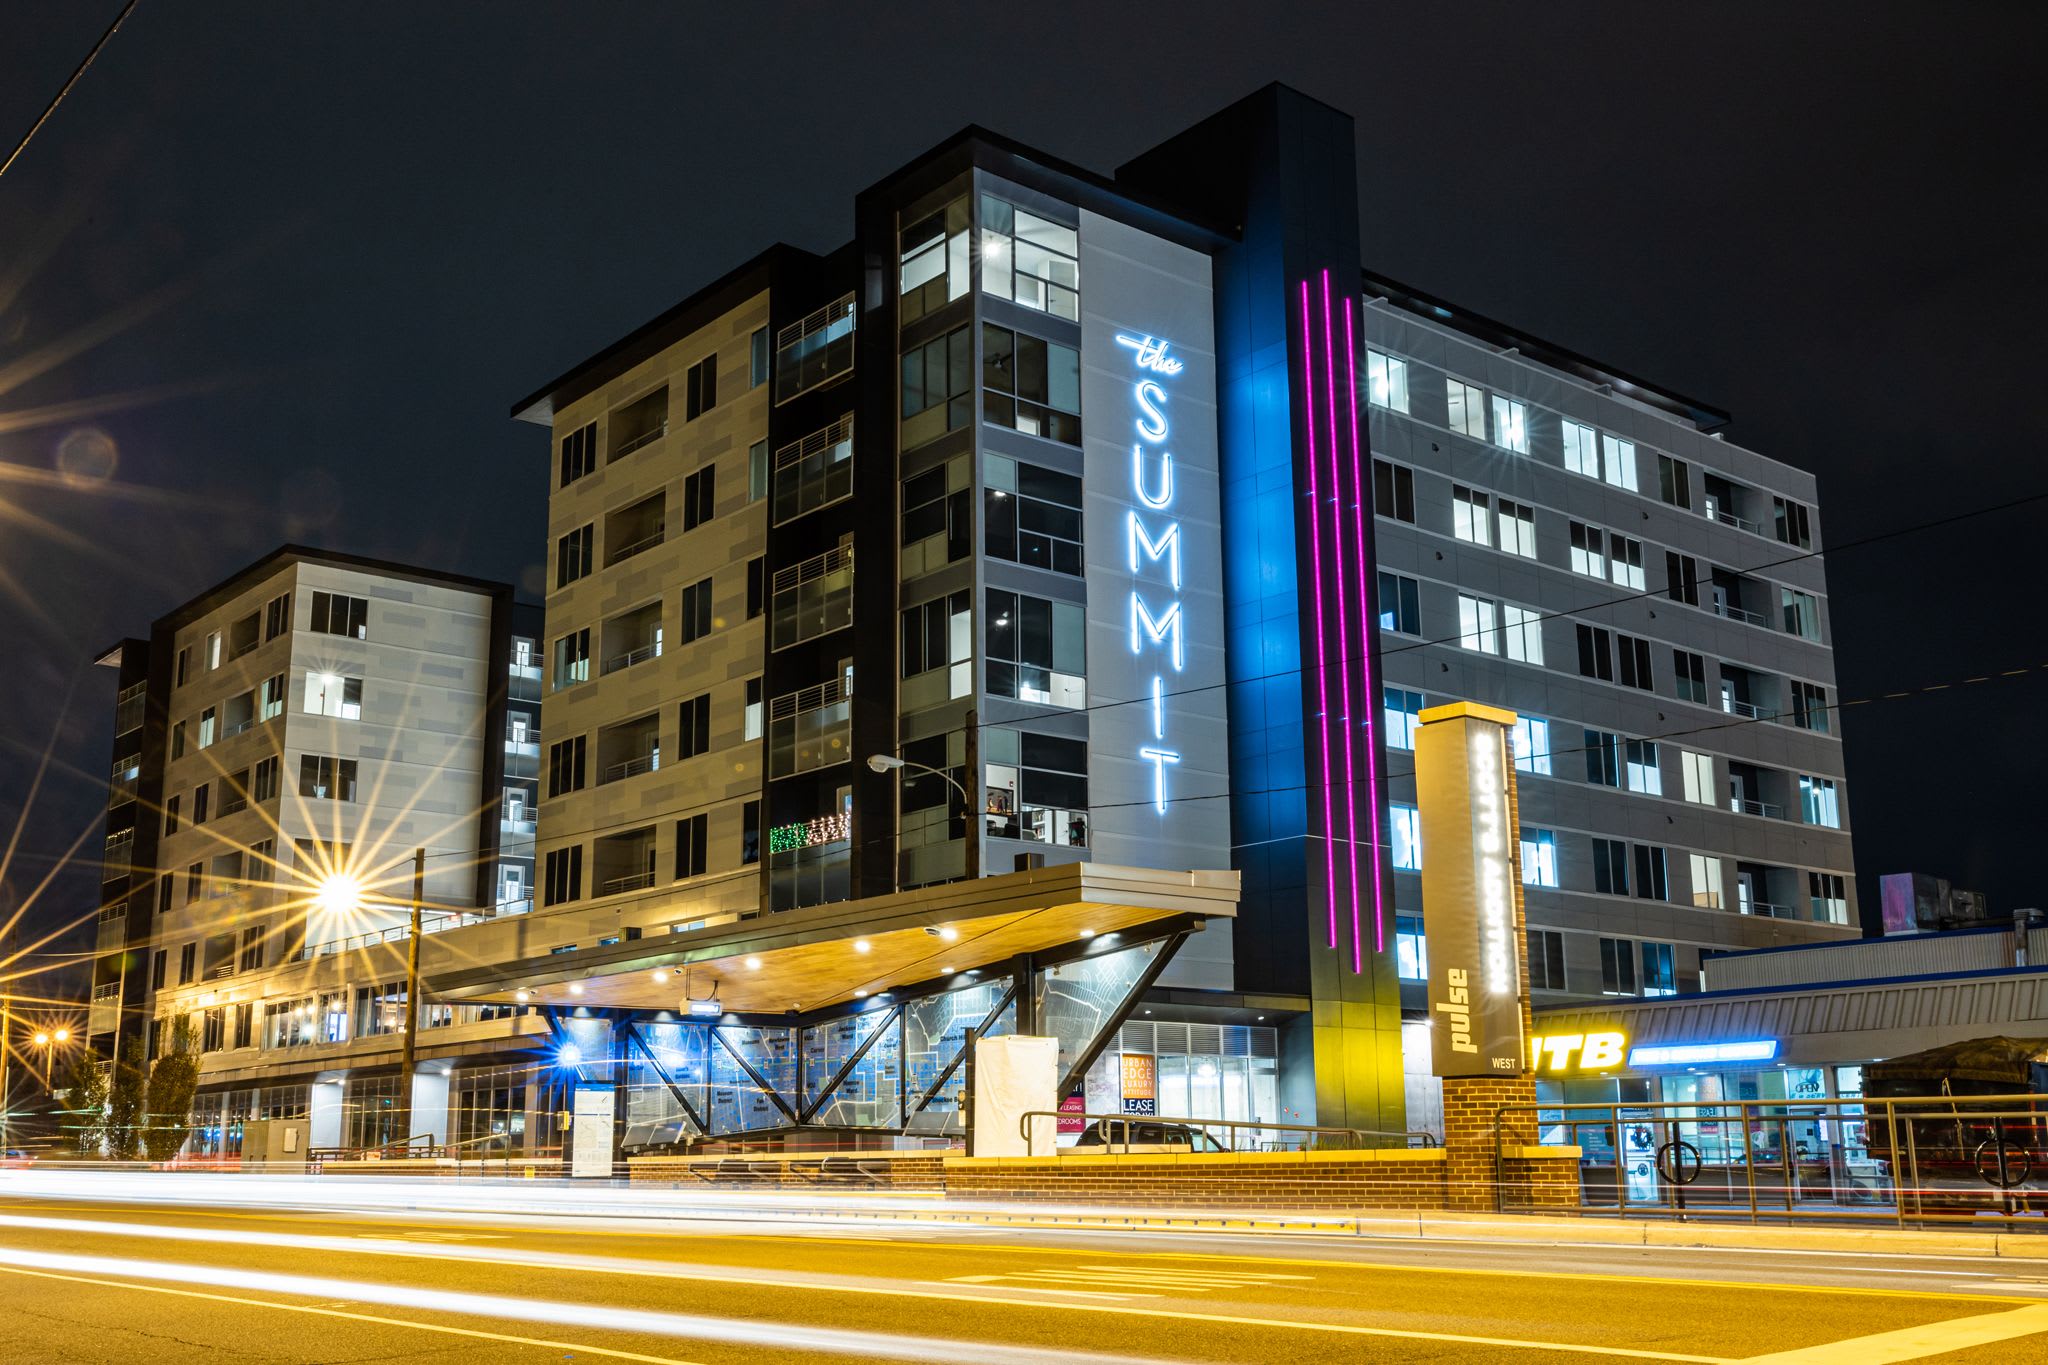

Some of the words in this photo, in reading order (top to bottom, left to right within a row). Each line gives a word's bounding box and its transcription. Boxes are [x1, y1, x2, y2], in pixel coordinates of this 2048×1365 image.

[1115, 335, 1184, 374] the
[1127, 380, 1183, 816] SUMMIT
[1436, 968, 1478, 1054] pulse
[1122, 1057, 1153, 1067] URBAN
[1492, 1057, 1516, 1070] WEST
[1123, 1067, 1152, 1079] EDGE
[1123, 1080, 1153, 1088] LUXURY
[1123, 1099, 1153, 1111] LEASE
